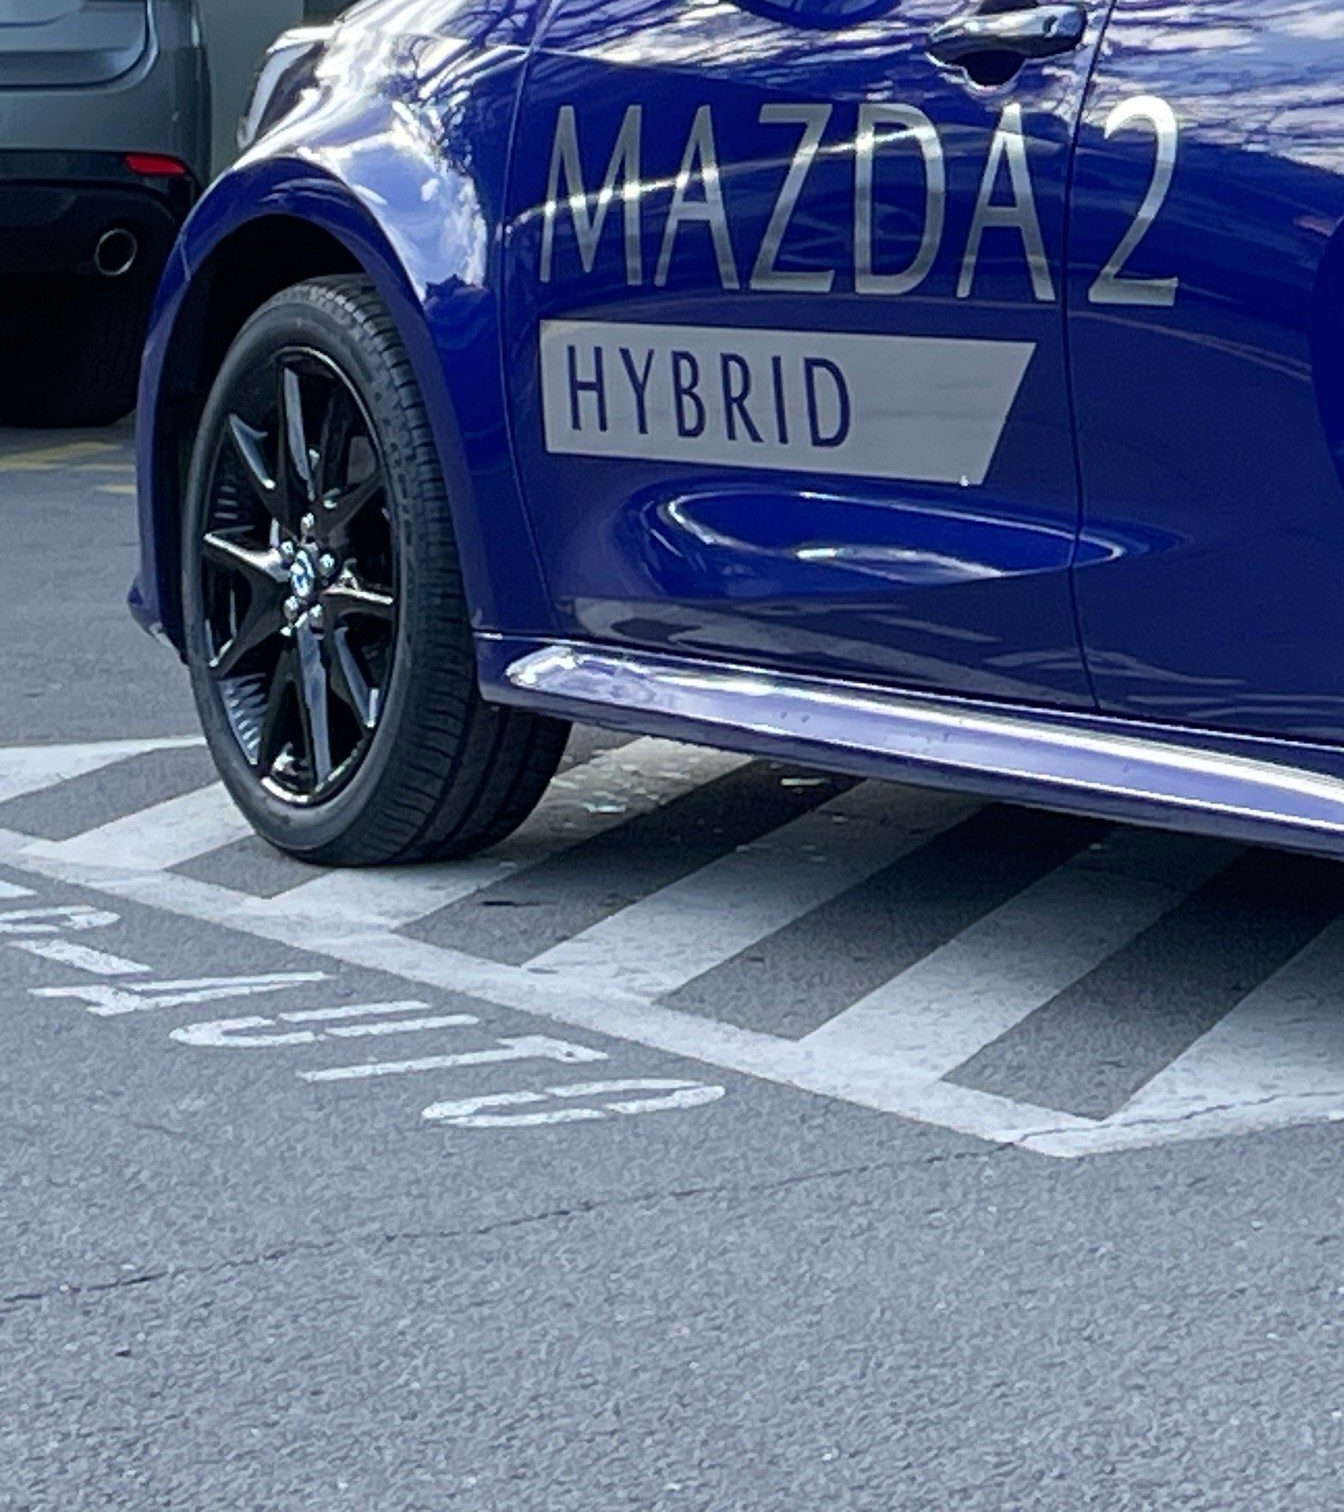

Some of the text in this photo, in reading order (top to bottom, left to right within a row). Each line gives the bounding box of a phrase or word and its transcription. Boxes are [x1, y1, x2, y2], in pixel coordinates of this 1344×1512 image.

[539, 94, 1179, 306] MAZDA 2
[567, 343, 852, 447] HYBRID
